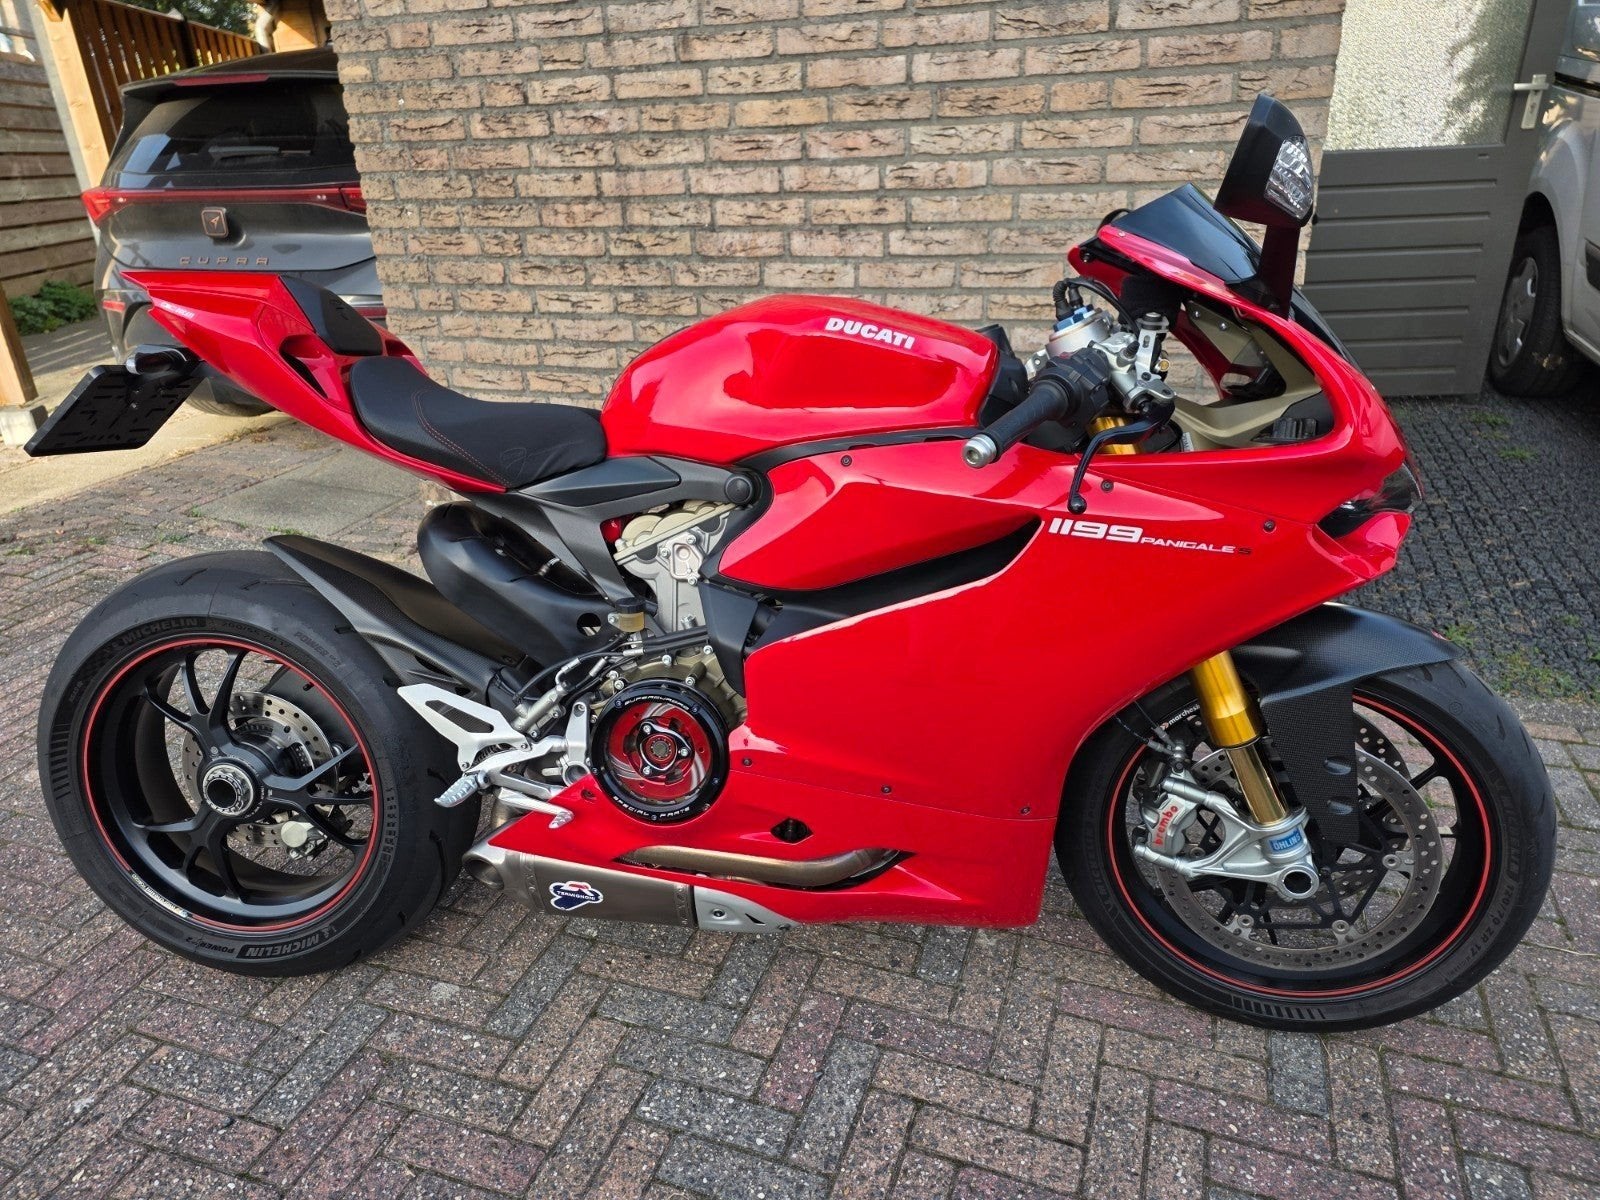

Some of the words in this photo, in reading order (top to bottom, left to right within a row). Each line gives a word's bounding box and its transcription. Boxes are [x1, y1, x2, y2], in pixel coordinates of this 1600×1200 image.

[180, 256, 269, 265] CUPRA
[825, 317, 915, 350] DUCATI
[1048, 517, 1144, 543] 1199
[1140, 536, 1236, 553] PANIGALE
[123, 618, 199, 645] MICHELIN
[294, 630, 330, 657] POWER
[613, 795, 650, 816] SPECIAL
[659, 806, 690, 818] PARTS
[1153, 805, 1178, 846] brembo
[556, 890, 596, 901] TERMIGNONI
[1480, 926, 1495, 943] ZR
[200, 941, 236, 954] POWER
[245, 935, 319, 957] MICHELIN
[1470, 944, 1482, 957] 17
